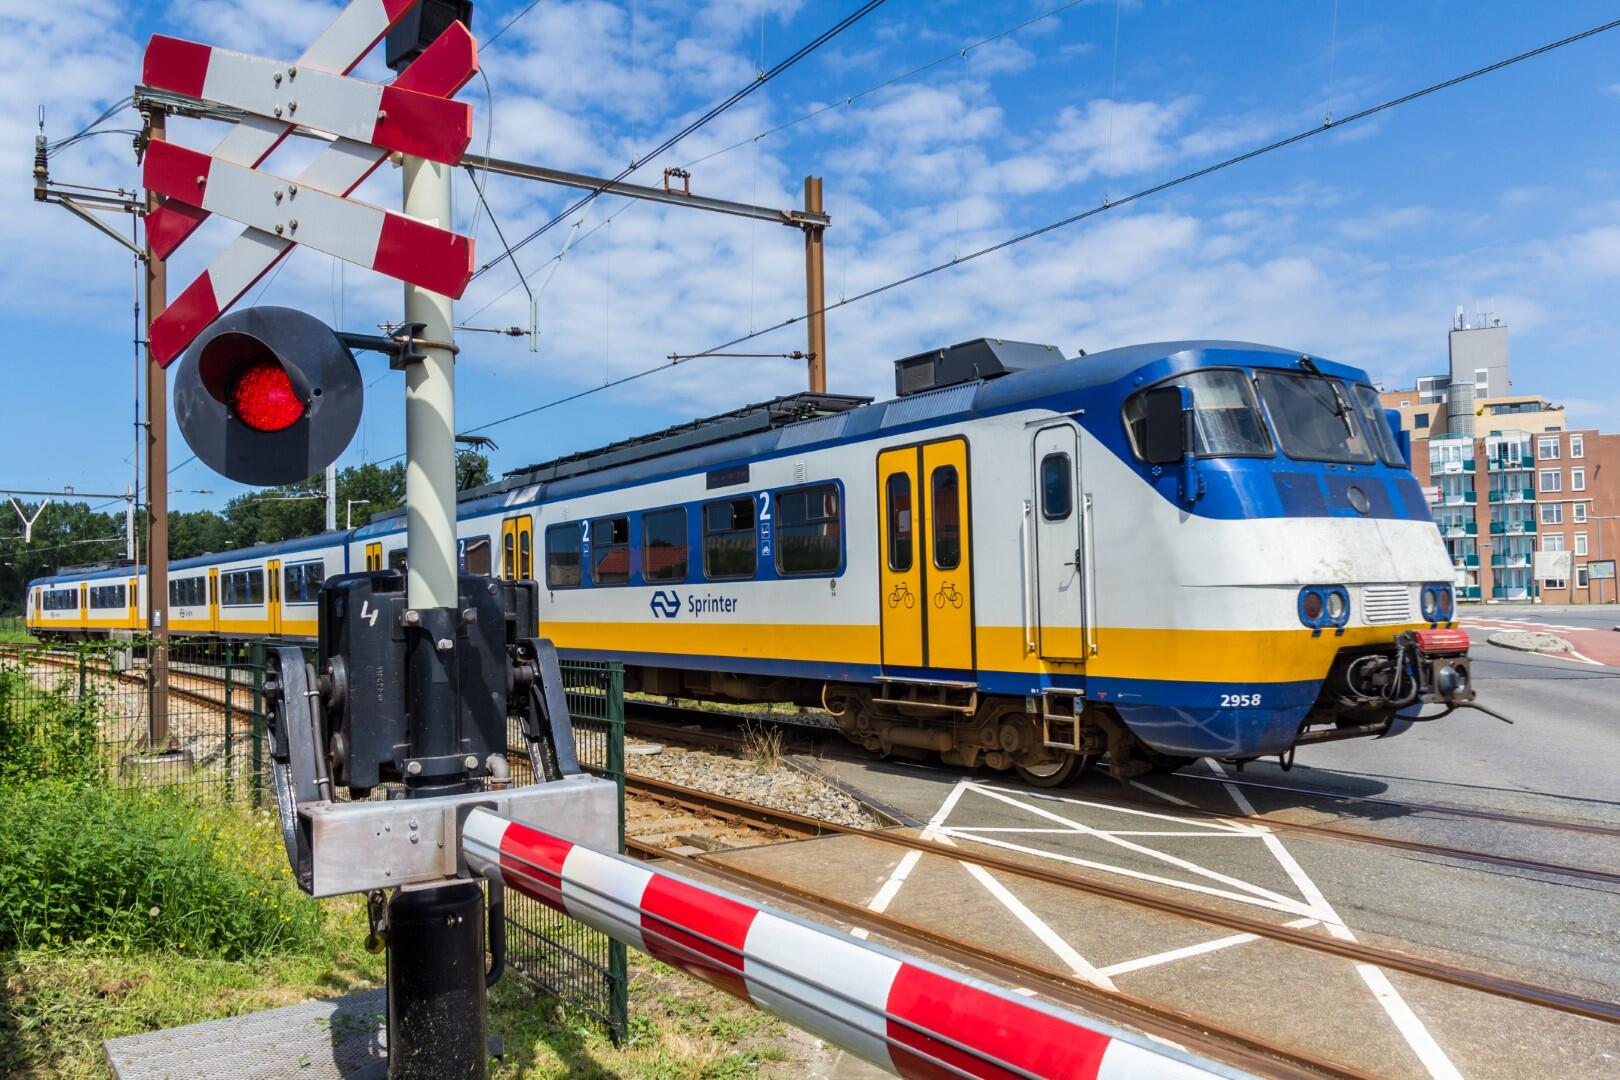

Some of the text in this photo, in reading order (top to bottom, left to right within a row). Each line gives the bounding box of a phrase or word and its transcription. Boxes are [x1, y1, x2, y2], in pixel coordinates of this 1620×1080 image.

[760, 492, 770, 519] 2
[582, 520, 590, 542] 2
[460, 539, 465, 557] 2
[360, 600, 379, 627] 4
[688, 594, 738, 617] Sprinter
[1220, 693, 1261, 708] 2958
